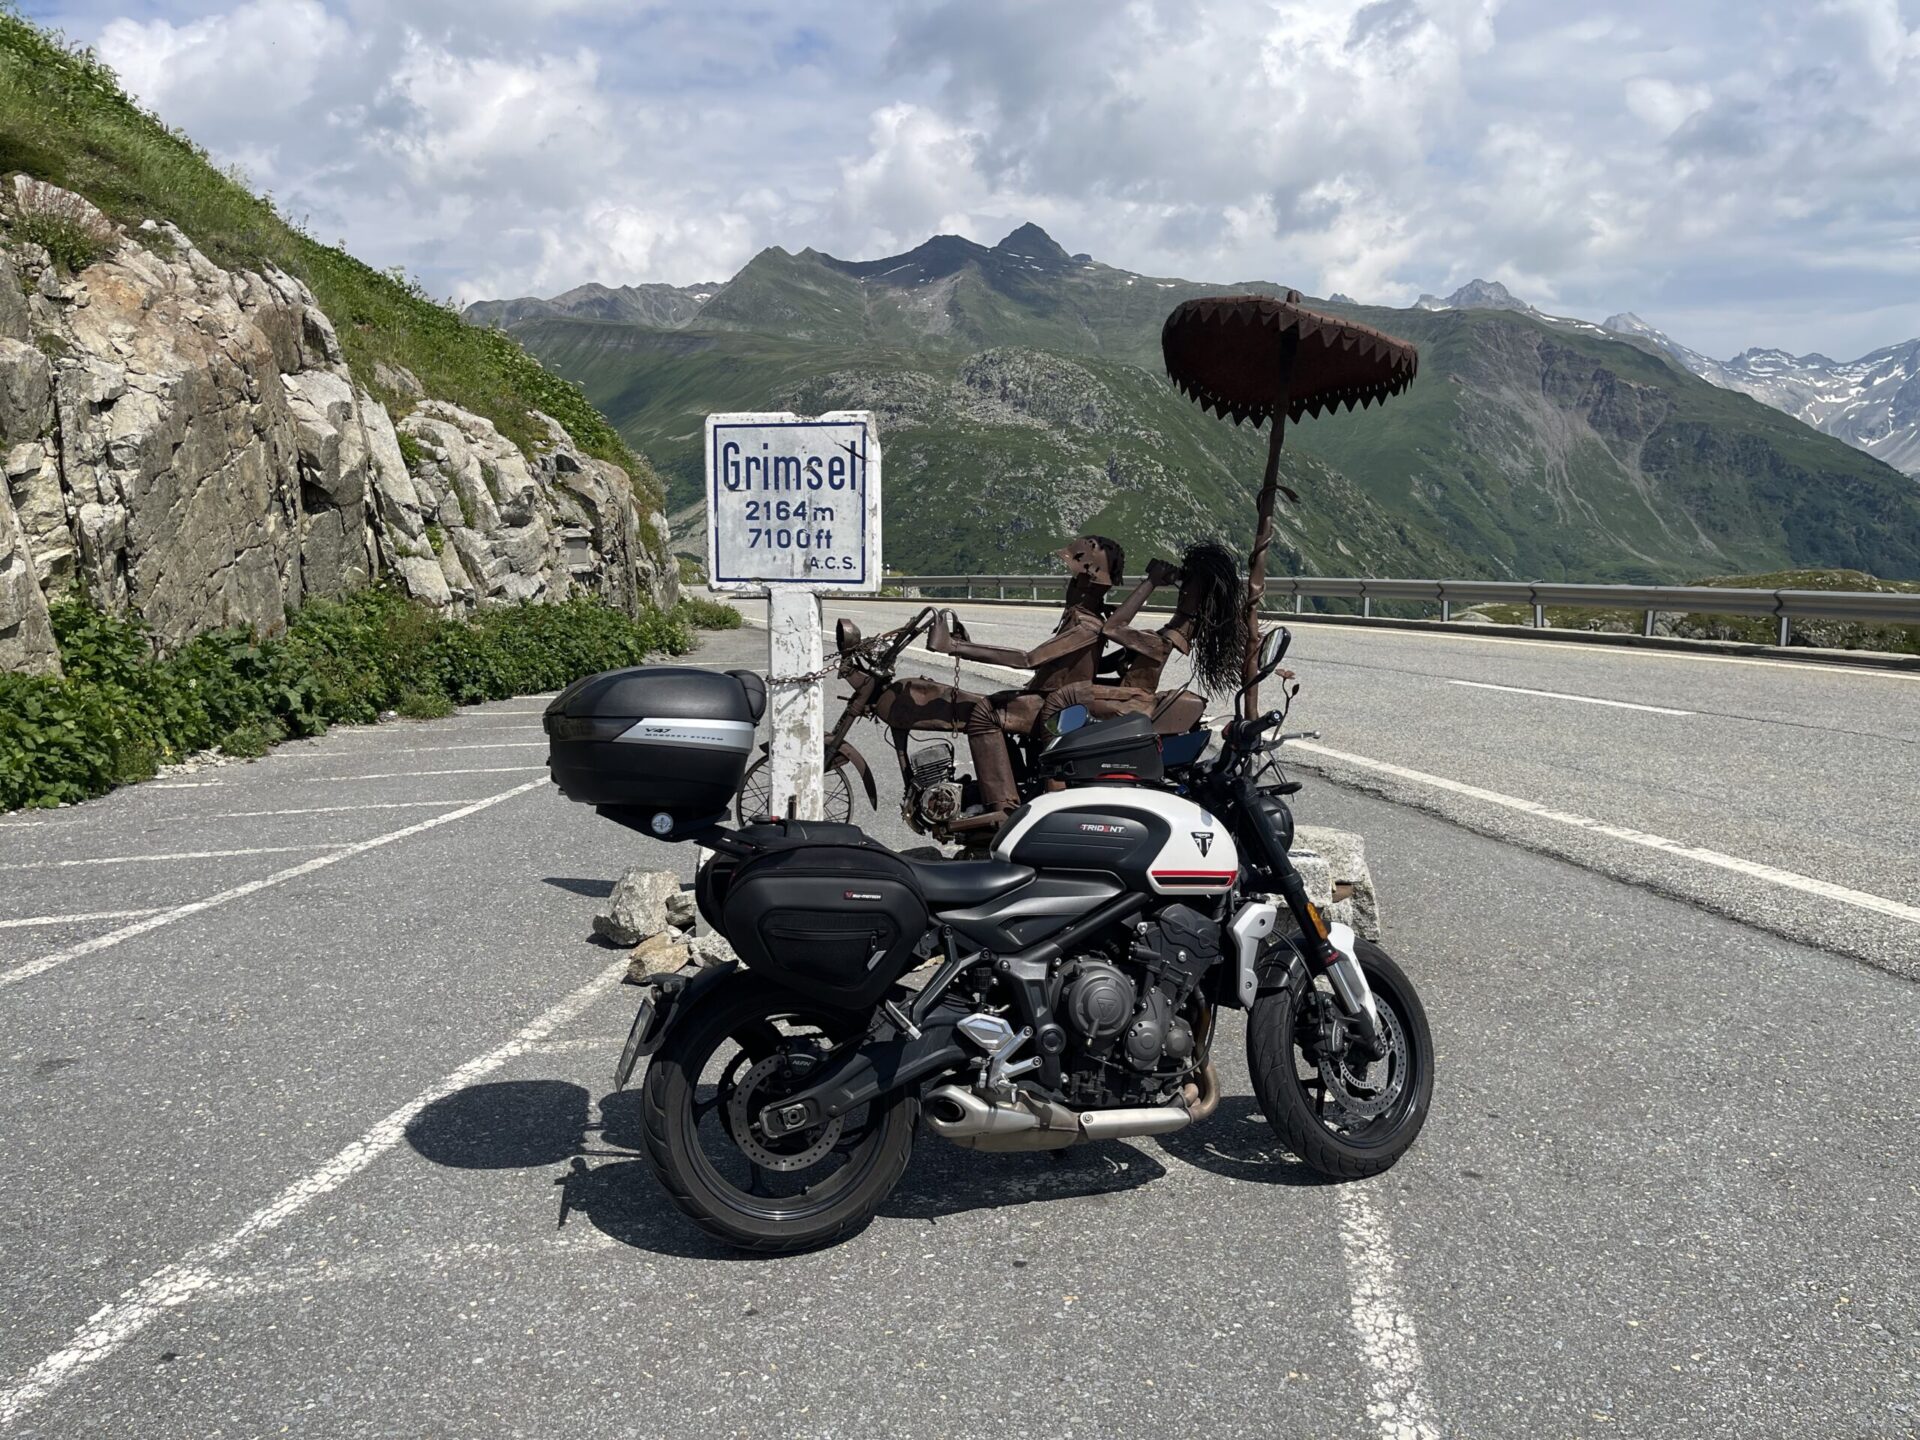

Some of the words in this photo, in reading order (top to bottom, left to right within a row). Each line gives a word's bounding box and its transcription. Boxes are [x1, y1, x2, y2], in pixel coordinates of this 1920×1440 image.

[722, 440, 857, 491] Grimsel
[745, 500, 808, 521] 2164
[813, 506, 834, 522] m
[748, 528, 811, 549] 7100
[815, 528, 833, 549] ft
[810, 555, 857, 570] A.C.S.
[1080, 823, 1125, 833] TRIDENT
